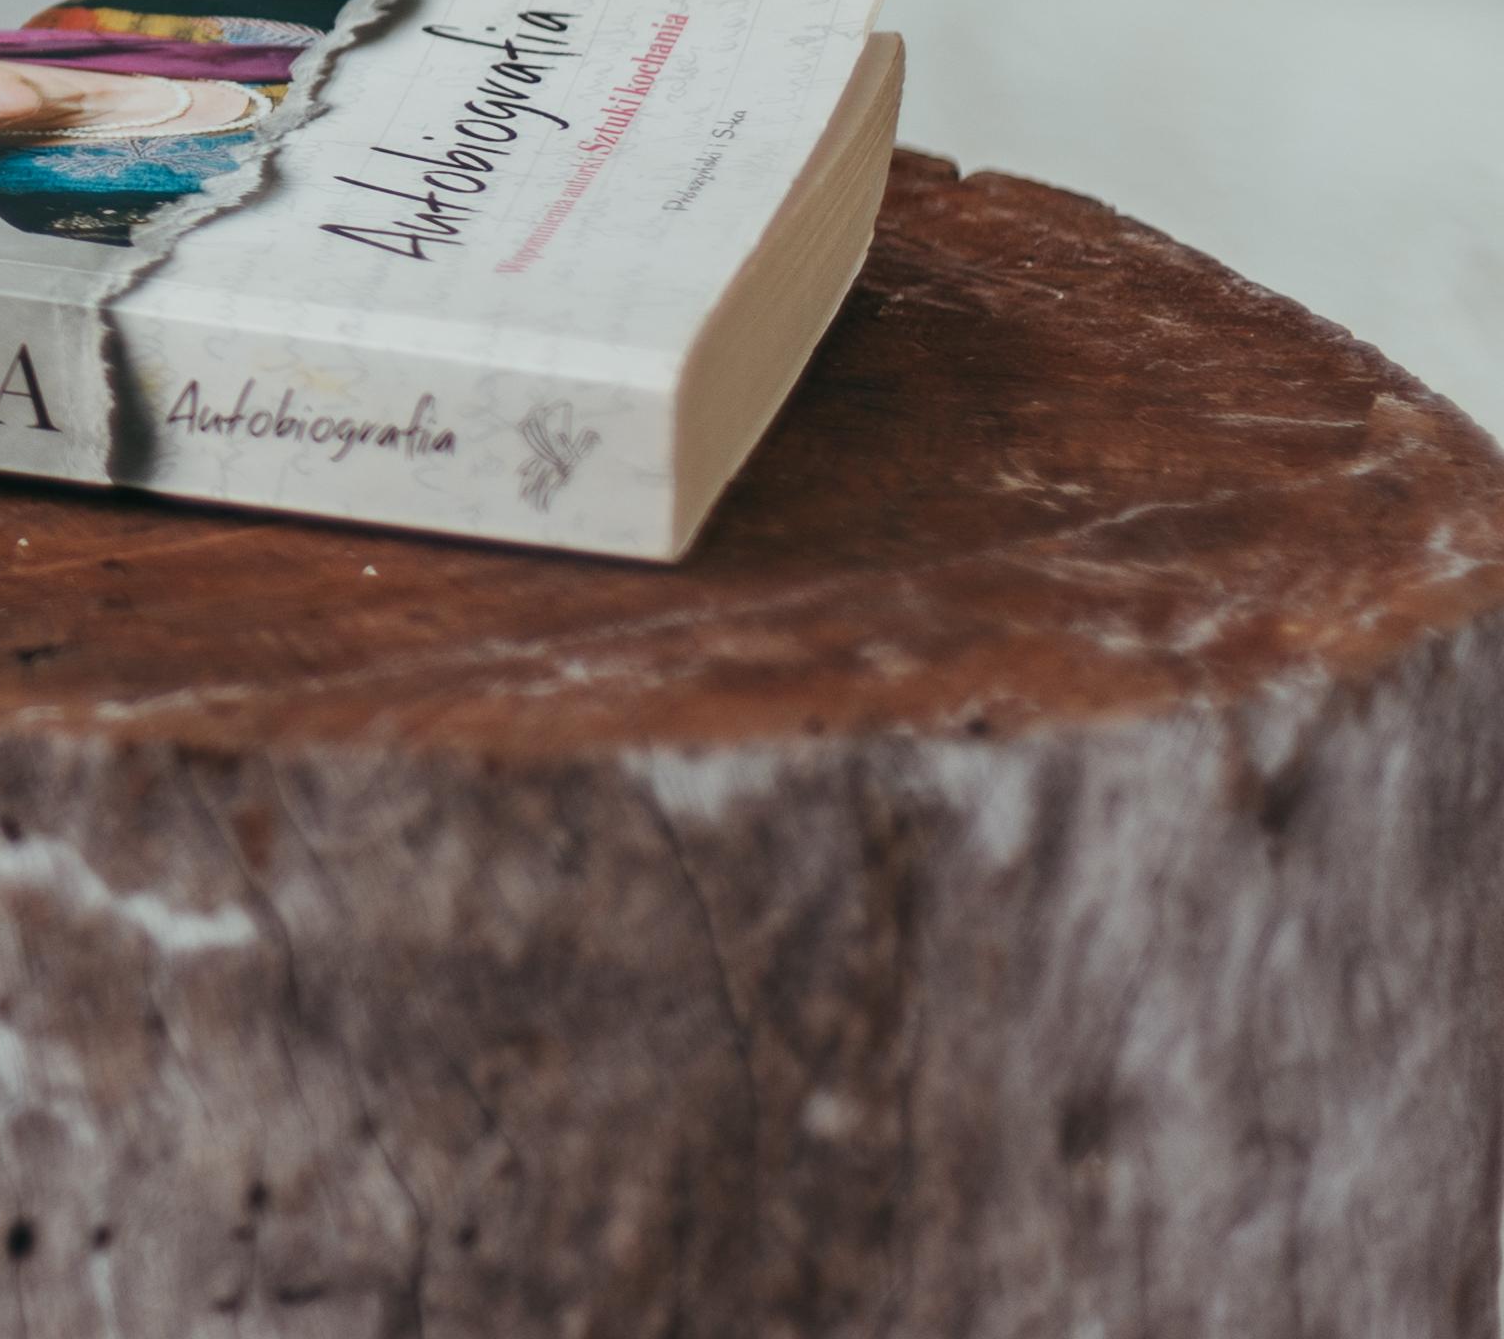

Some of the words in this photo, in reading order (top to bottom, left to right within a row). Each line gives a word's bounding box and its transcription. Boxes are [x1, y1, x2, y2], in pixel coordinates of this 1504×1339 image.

[611, 13, 690, 97] kochania
[318, 9, 583, 262] Autobiografia
[577, 94, 644, 156] Sztuki
[711, 109, 748, 140] S-ka
[561, 156, 608, 199] autorki
[166, 377, 457, 464] Autobiografia
